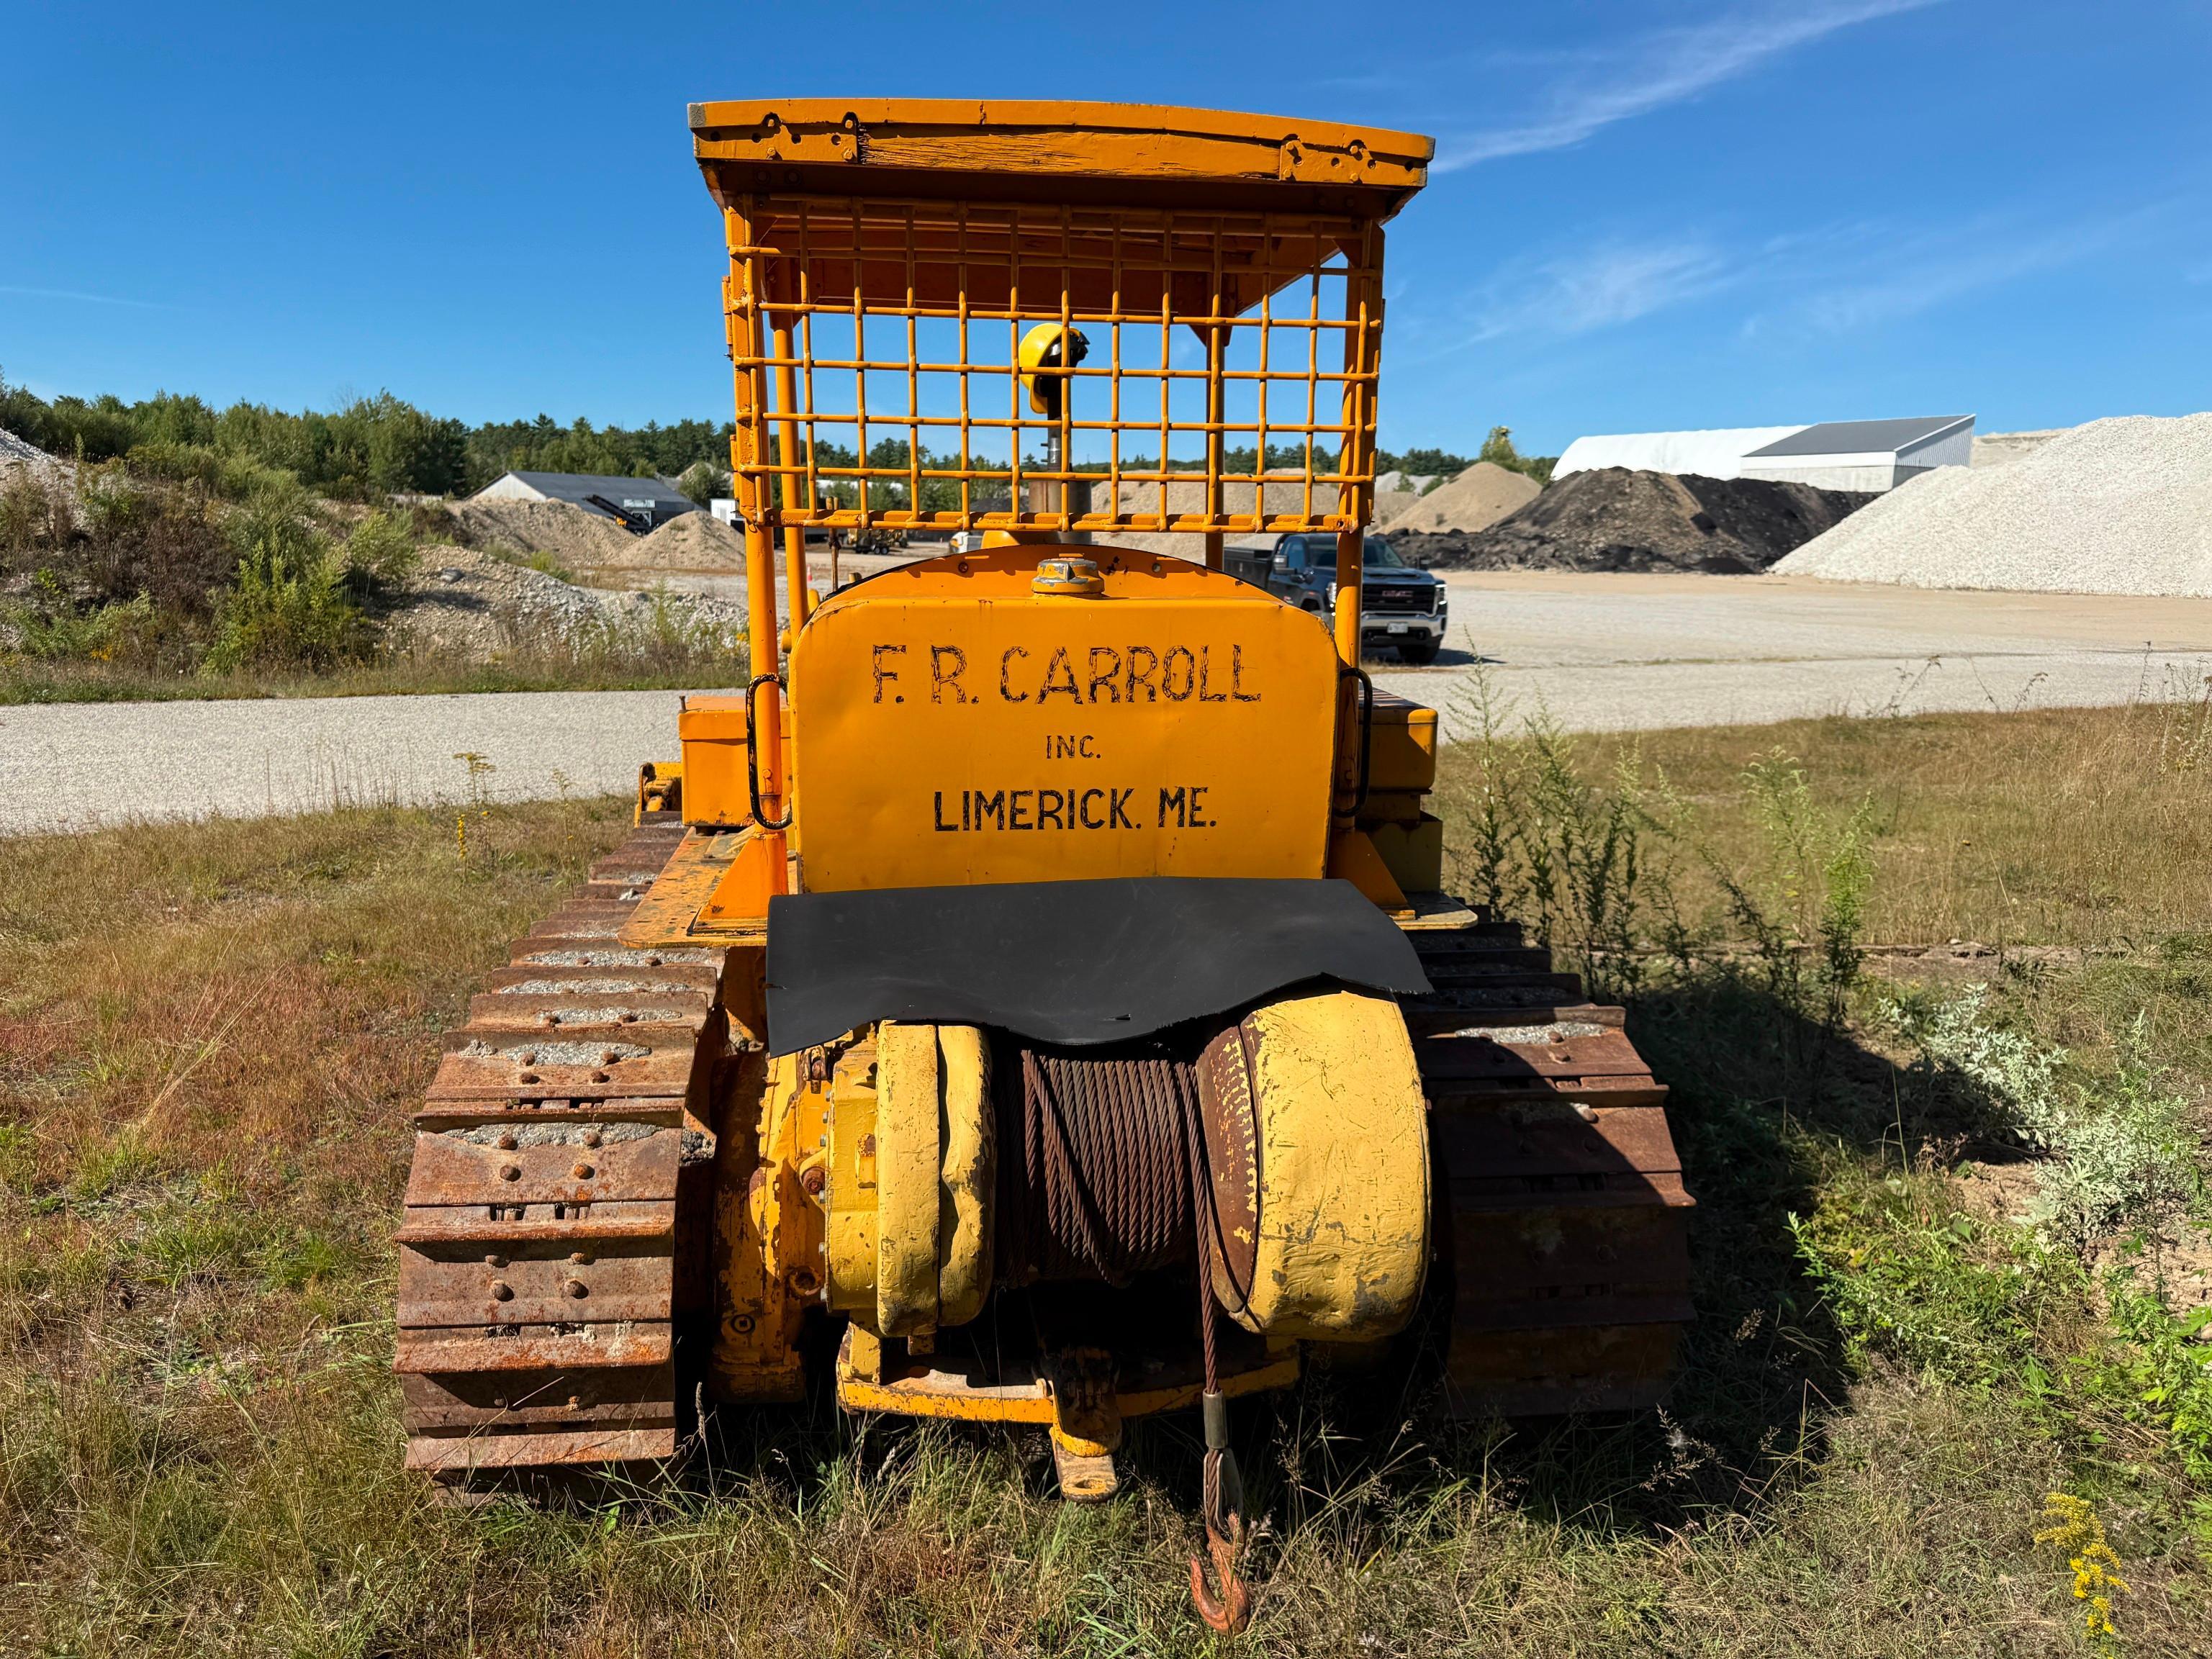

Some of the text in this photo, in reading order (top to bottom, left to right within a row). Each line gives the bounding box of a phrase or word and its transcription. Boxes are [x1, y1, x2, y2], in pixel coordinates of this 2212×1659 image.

[871, 643, 1262, 705] F. R. CARROLL
[1045, 734, 1101, 760] INC.
[1157, 786, 1217, 828] ME.
